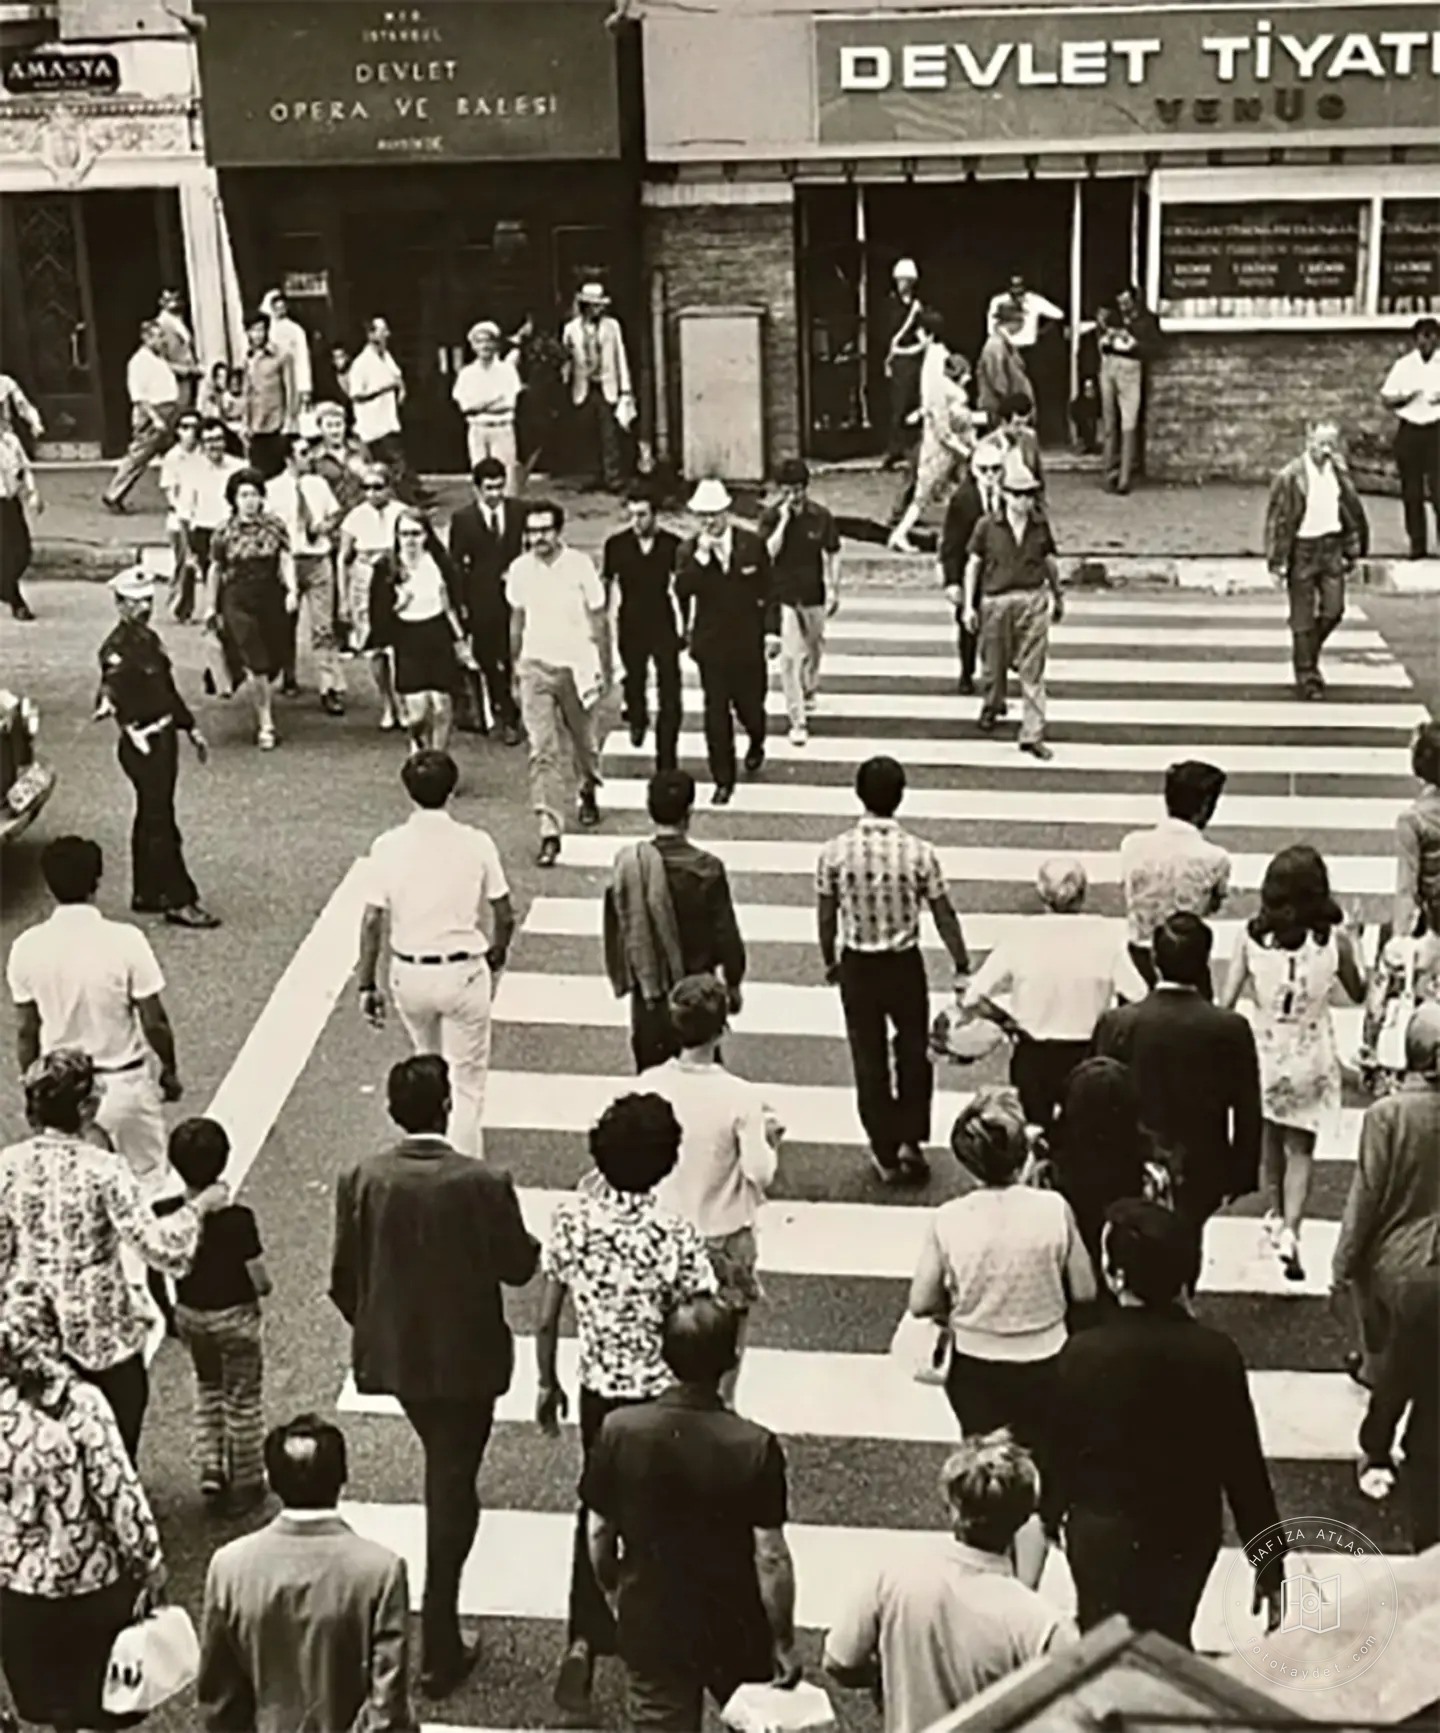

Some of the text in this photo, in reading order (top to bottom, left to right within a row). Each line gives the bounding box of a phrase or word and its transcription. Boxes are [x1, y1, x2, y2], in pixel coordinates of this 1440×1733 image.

[839, 21, 1440, 90] DEVLET TİYAT
[8, 60, 112, 78] AMASYA
[355, 60, 457, 83] DEVLET
[269, 101, 369, 122] OPERA
